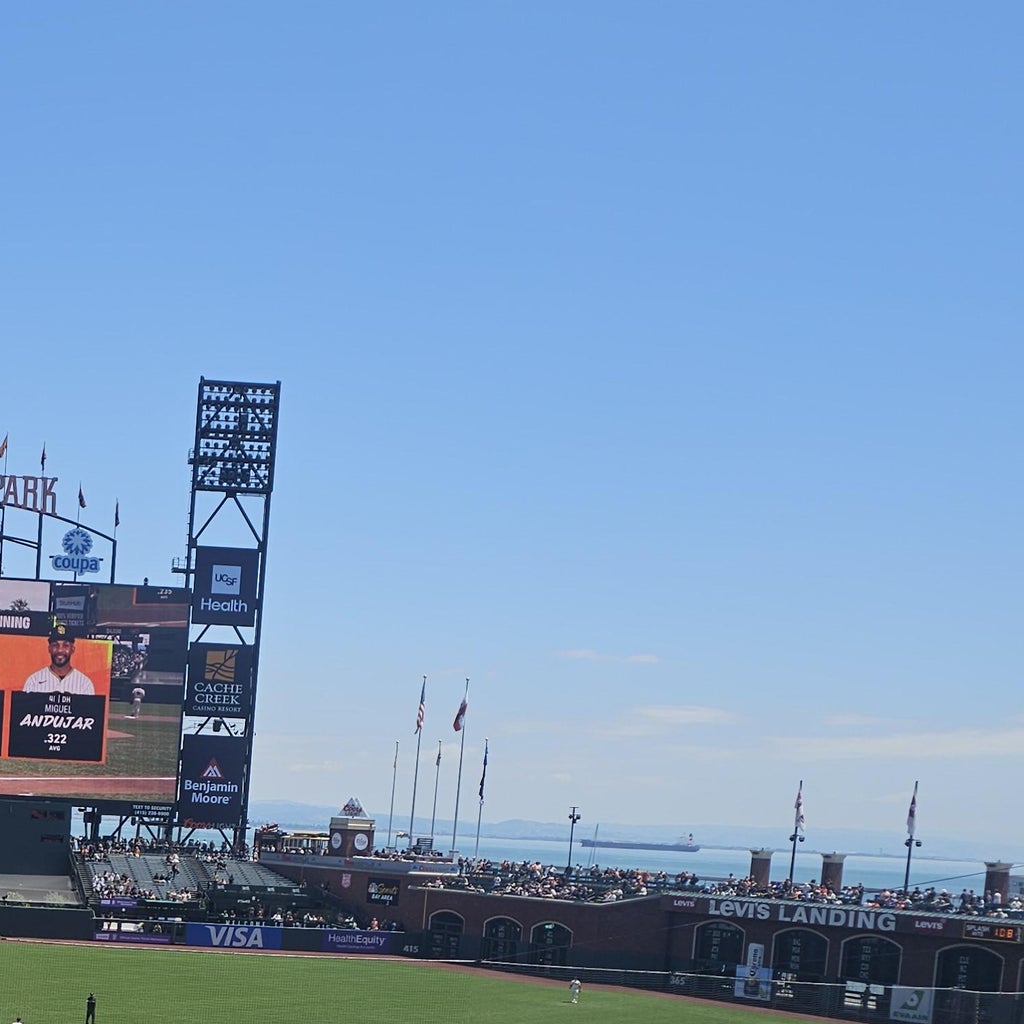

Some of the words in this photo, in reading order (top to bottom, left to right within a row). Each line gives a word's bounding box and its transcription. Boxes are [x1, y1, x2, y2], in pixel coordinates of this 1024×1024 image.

[54, 554, 98, 575] coupa
[215, 573, 238, 586] UCSF
[201, 598, 247, 613] Health
[194, 682, 243, 695] CACHE
[195, 693, 240, 705] CREEK
[44, 704, 72, 714] MIGUEL
[19, 713, 95, 730] ANDUJAR
[44, 733, 67, 744] .322
[184, 779, 238, 794] Benjamin
[191, 792, 230, 805] Moore
[779, 905, 896, 932] LANDING
[205, 925, 264, 948] VISA
[328, 933, 385, 946] HealthEquity
[994, 927, 1014, 939] 108
[403, 945, 419, 953] 415
